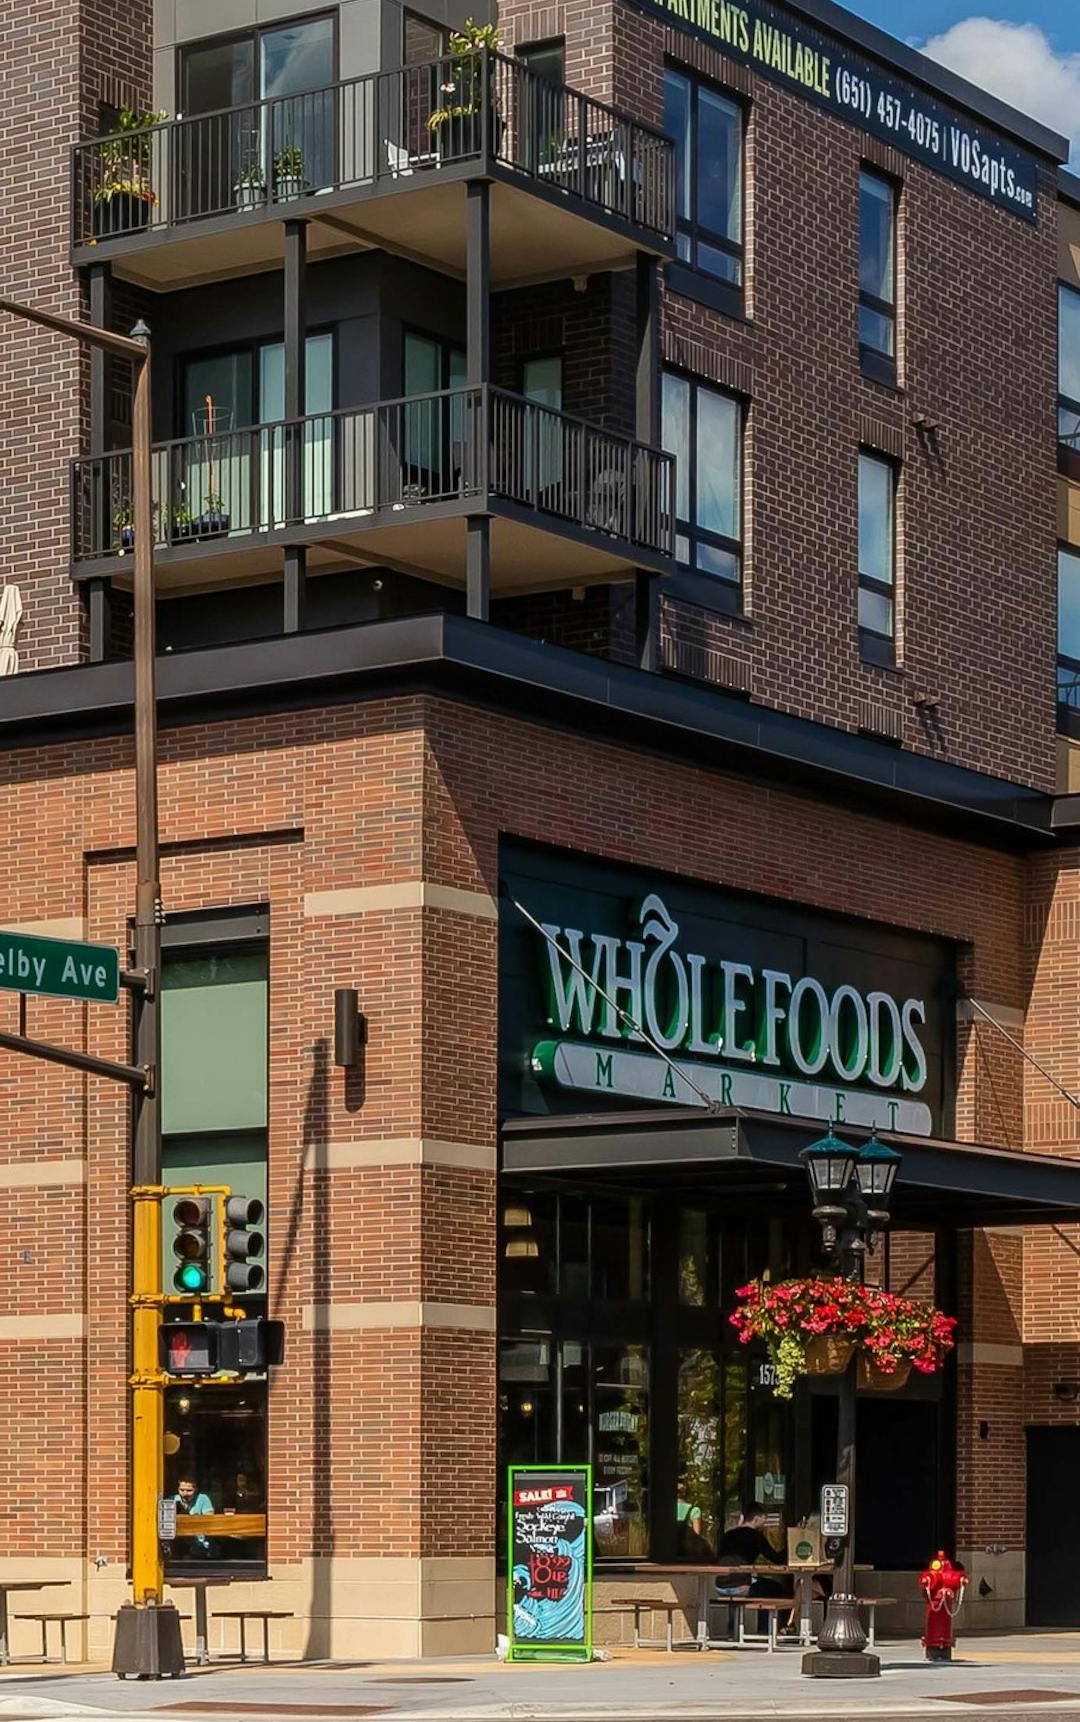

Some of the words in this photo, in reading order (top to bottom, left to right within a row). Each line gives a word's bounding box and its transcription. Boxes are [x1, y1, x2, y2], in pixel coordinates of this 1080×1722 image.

[753, 18, 831, 98] AVAILABLE
[835, 66, 871, 119] (651)
[877, 91, 939, 154] 457-4075
[61, 955, 107, 987] Ave
[541, 893, 754, 1063] WHOLE
[761, 968, 928, 1092] FOODS
[595, 1051, 900, 1132] MARKET
[519, 1489, 552, 1502] SALE!
[516, 1519, 566, 1535] Sockeye
[516, 1531, 558, 1543] Salmon
